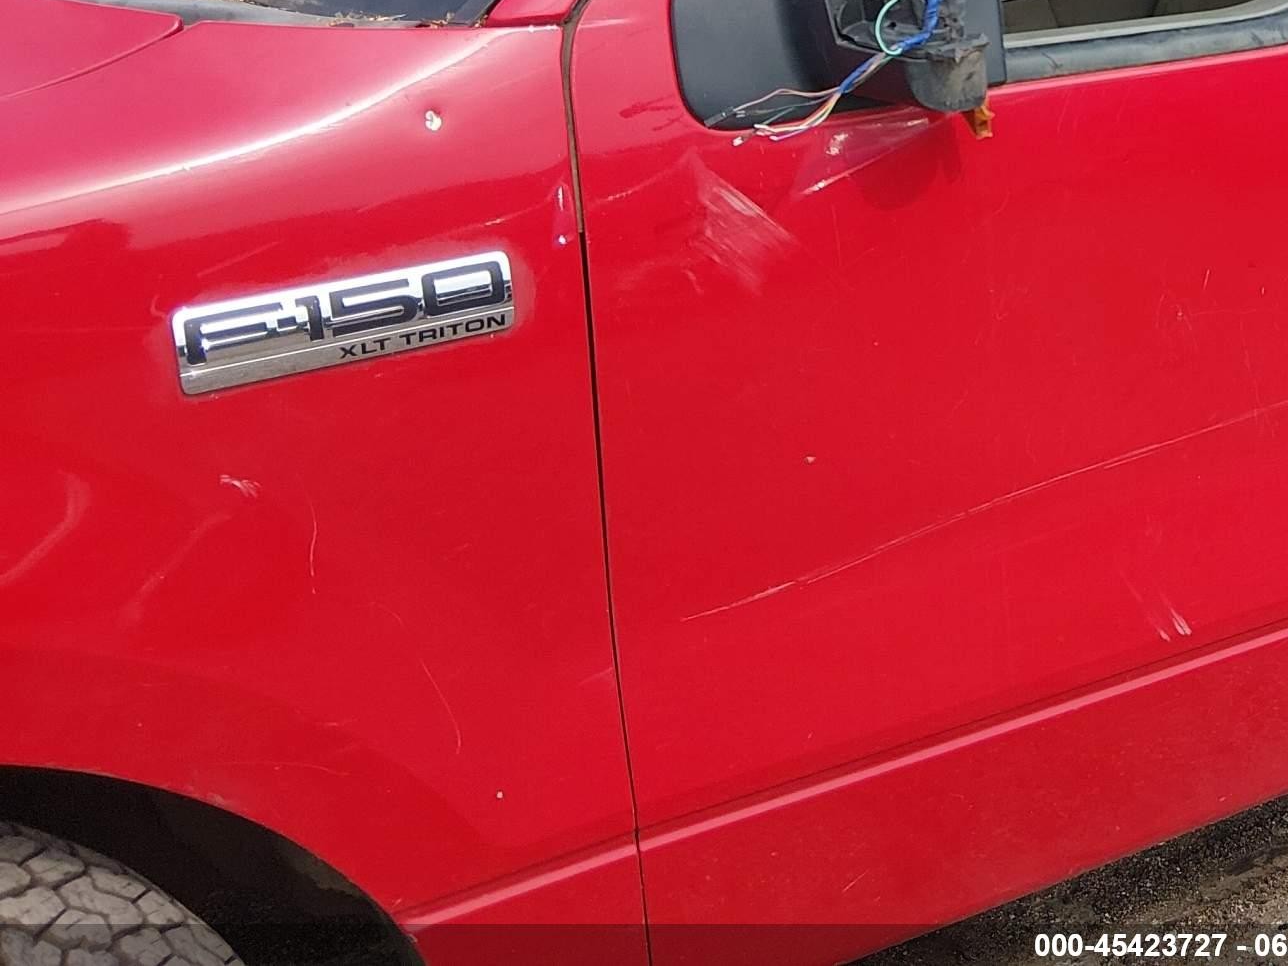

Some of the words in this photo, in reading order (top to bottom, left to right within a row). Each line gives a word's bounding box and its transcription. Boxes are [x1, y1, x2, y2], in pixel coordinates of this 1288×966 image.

[182, 259, 507, 367] F-150
[340, 338, 392, 361] XLT
[399, 314, 507, 347] TRITON
